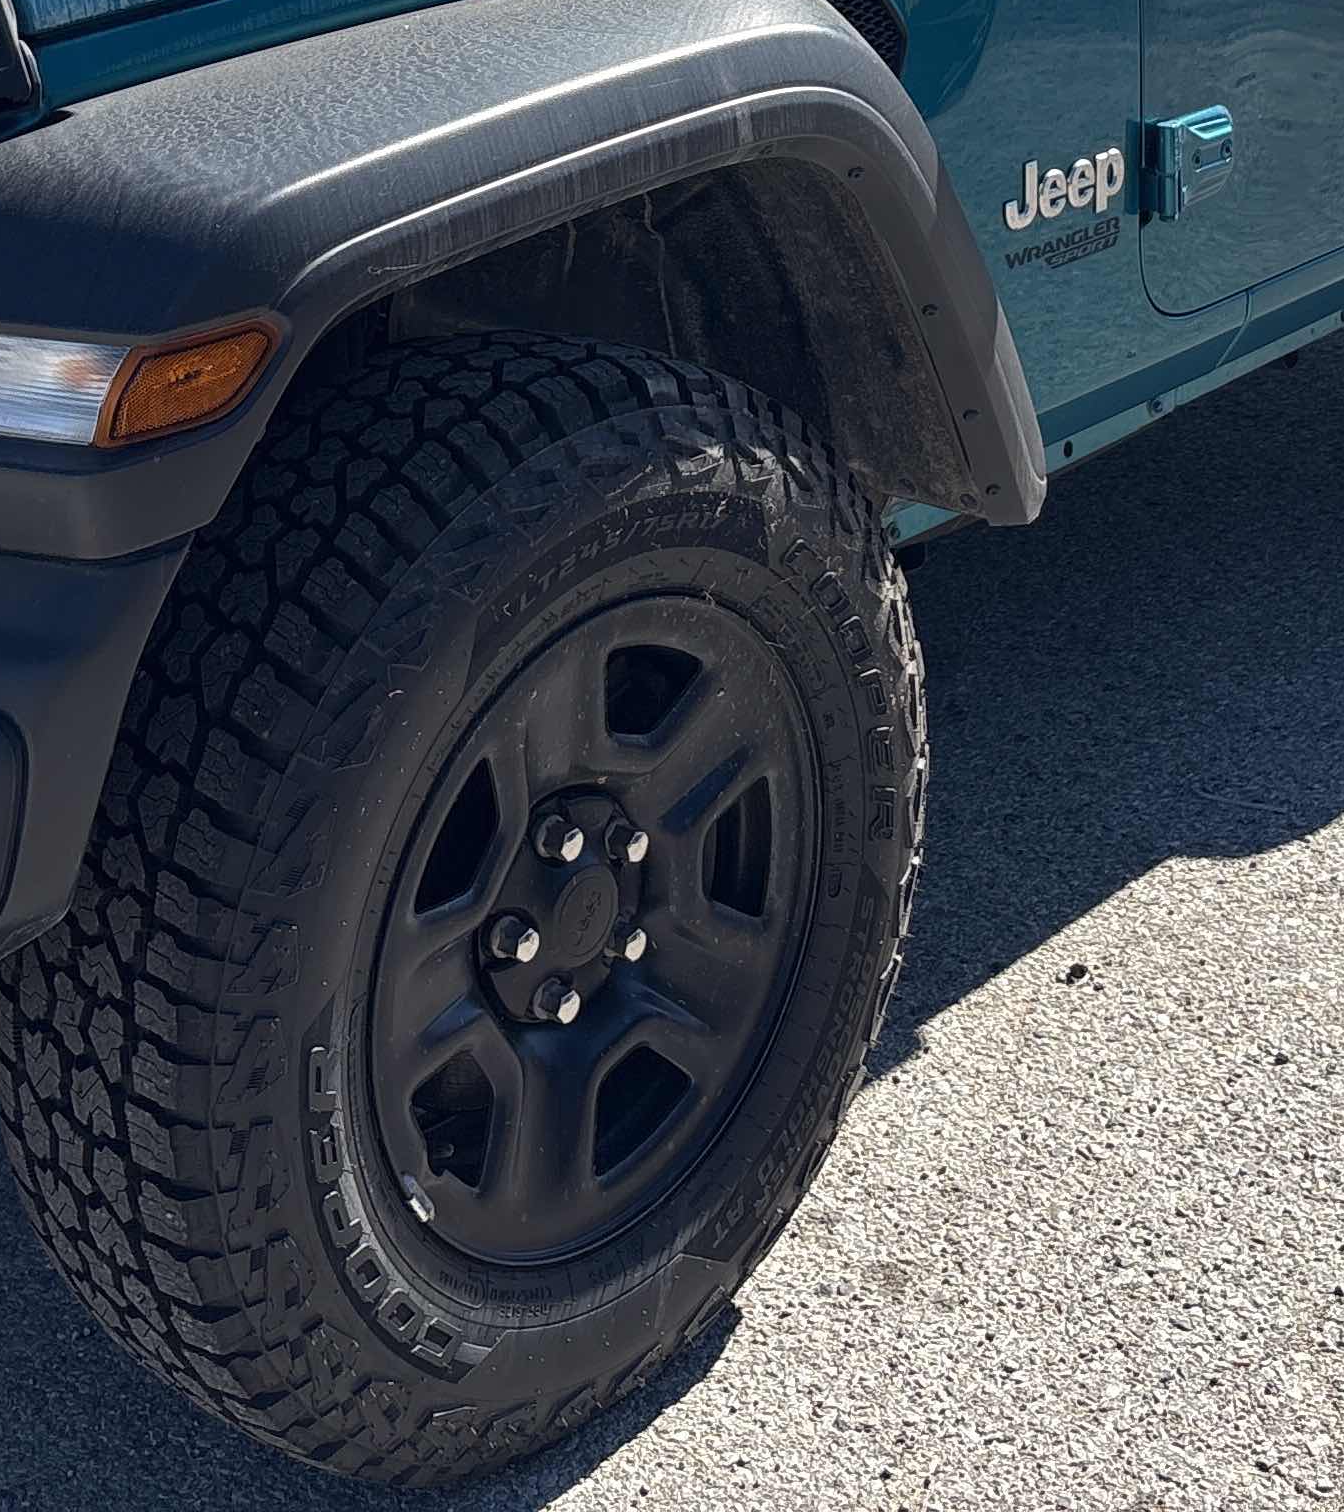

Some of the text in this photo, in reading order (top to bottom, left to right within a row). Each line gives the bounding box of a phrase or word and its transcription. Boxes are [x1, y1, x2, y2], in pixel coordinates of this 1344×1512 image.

[1004, 147, 1125, 230] Jeep
[1004, 216, 1120, 269] WRANGLER
[308, 1044, 463, 1368] COOPER
